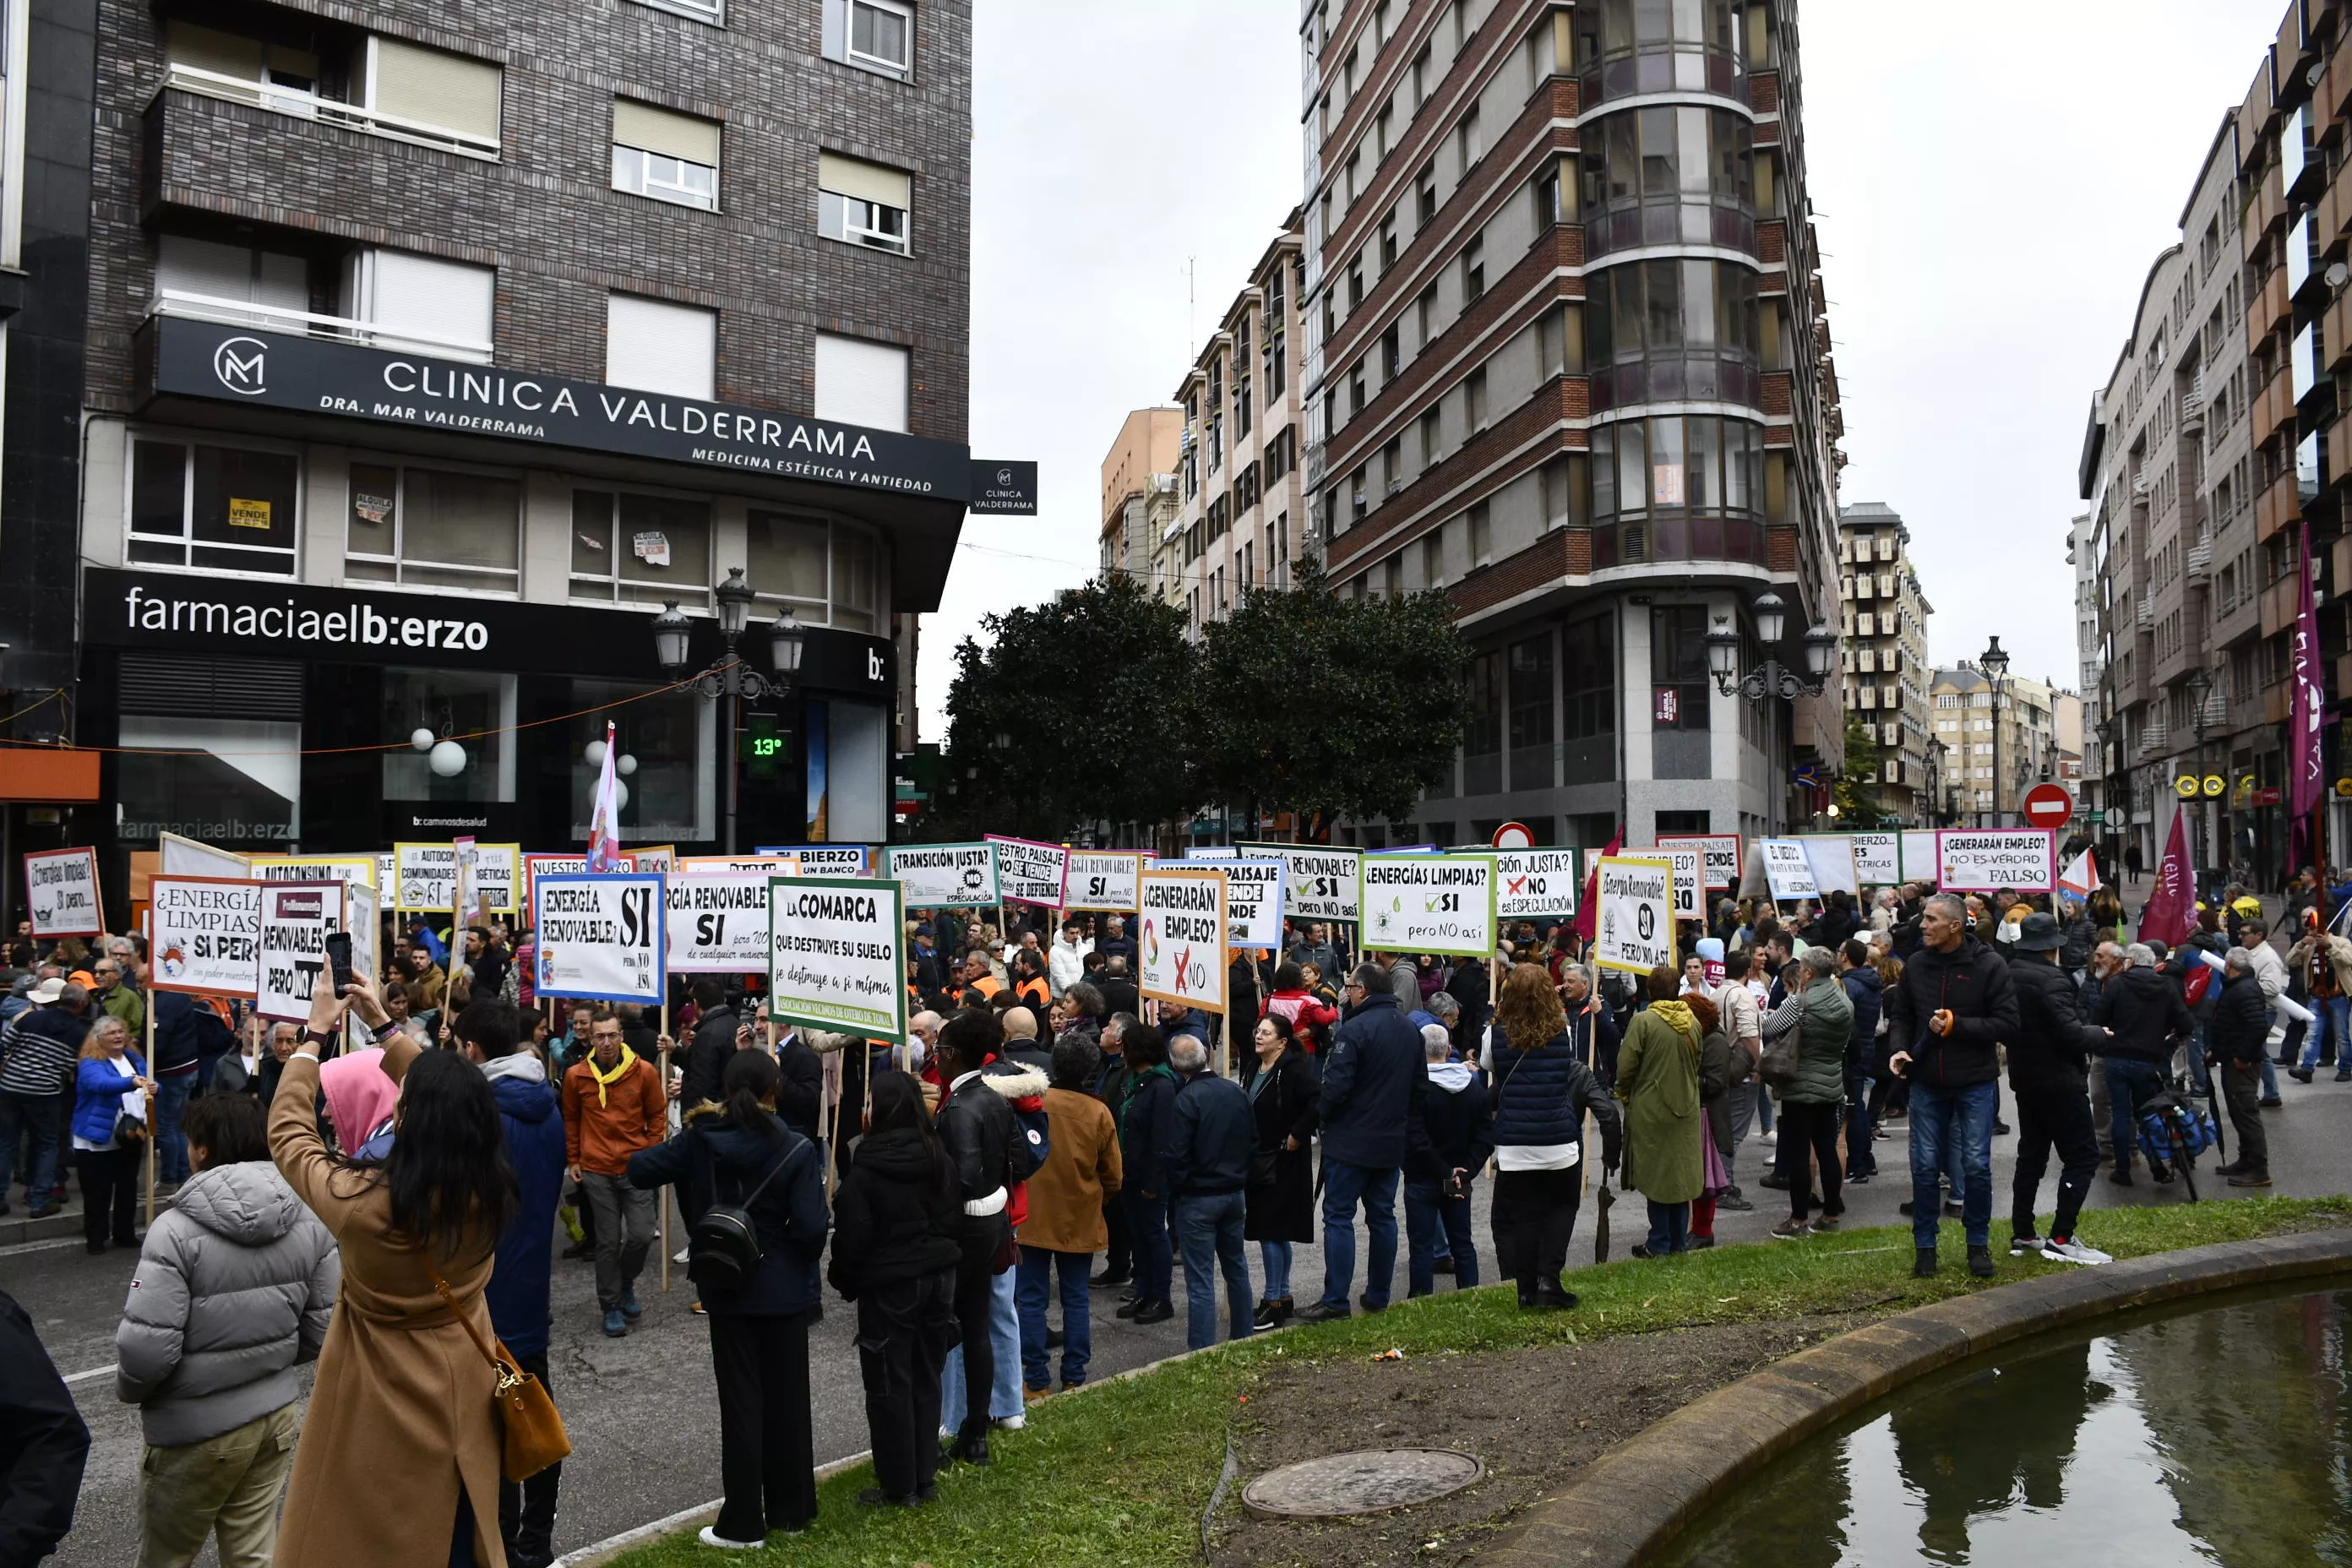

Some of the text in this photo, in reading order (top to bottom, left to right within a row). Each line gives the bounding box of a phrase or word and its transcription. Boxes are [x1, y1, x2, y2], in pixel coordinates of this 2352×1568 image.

[320, 395, 545, 438] DRA. MAR VALDERRAMA
[384, 362, 876, 461] CLINICA VALDERRAMA
[692, 448, 932, 492] MEDICINA ESTÉTICA Y ANTIEDAD
[357, 494, 392, 507] ALQUILA
[974, 499, 1033, 510] VALDERRAMA
[231, 509, 269, 520] VENDE
[1945, 835, 2045, 852] ¿GENERARÁN EMPLEO?
[800, 850, 859, 863] BIERZO
[894, 848, 988, 873] ¿TRANSICIÓN JUSTA?
[1028, 847, 1064, 866] PAISAJE
[1090, 858, 1135, 874] RENOVABLE?
[1526, 853, 1569, 873] JUSTA?
[1950, 855, 2040, 864] NO ES VERDAD
[819, 866, 855, 874] BANCO
[1014, 861, 1024, 876] SE
[1025, 863, 1052, 881] VENDE
[1227, 867, 1277, 882] PAISAJE
[1293, 857, 1356, 877] RENOVABLE?
[1366, 863, 1487, 886] ¿ENERGÍAS LIMPIAS?
[1989, 869, 2047, 883] FALSO
[966, 873, 981, 884] NO
[1088, 876, 1106, 896] SI
[1315, 877, 1339, 897] SI
[1528, 878, 1546, 895] NO
[1603, 872, 1664, 901] ¿Energía Renovable?
[542, 884, 601, 917] ¿ENERGÍA
[946, 890, 993, 903] ESPECULACIÓN
[1015, 883, 1059, 898] SE DEFIENDE
[1122, 887, 1132, 896] NO
[1144, 880, 1216, 912] ¿GENERARÁN
[787, 894, 877, 923] LA COMARCA
[1298, 902, 1320, 915] pero
[1324, 901, 1340, 917] NO
[1441, 893, 1459, 912] SI
[1502, 895, 1572, 913] es ESPECULACIÓN
[620, 887, 651, 948] SI
[542, 920, 618, 944] RENOVABLE?
[695, 913, 725, 946] SI
[1165, 915, 1216, 945] EMPLEO?
[1408, 923, 1482, 939] pero NO así
[217, 936, 259, 962] PER
[264, 925, 323, 955] RENOVABLES
[732, 933, 750, 948] pero
[776, 934, 891, 961] QUE DESTRUYE SU SUELO
[637, 952, 650, 968] NO
[688, 948, 697, 960] de
[700, 949, 737, 964] cualquier
[1621, 942, 1642, 961] PERO
[1642, 944, 1653, 962] NO
[268, 967, 310, 999] PERO NO
[1189, 962, 1206, 989] NO
[780, 998, 891, 1026] ASOCIACIÓN VECINOS DE OTERO DE TORAL
